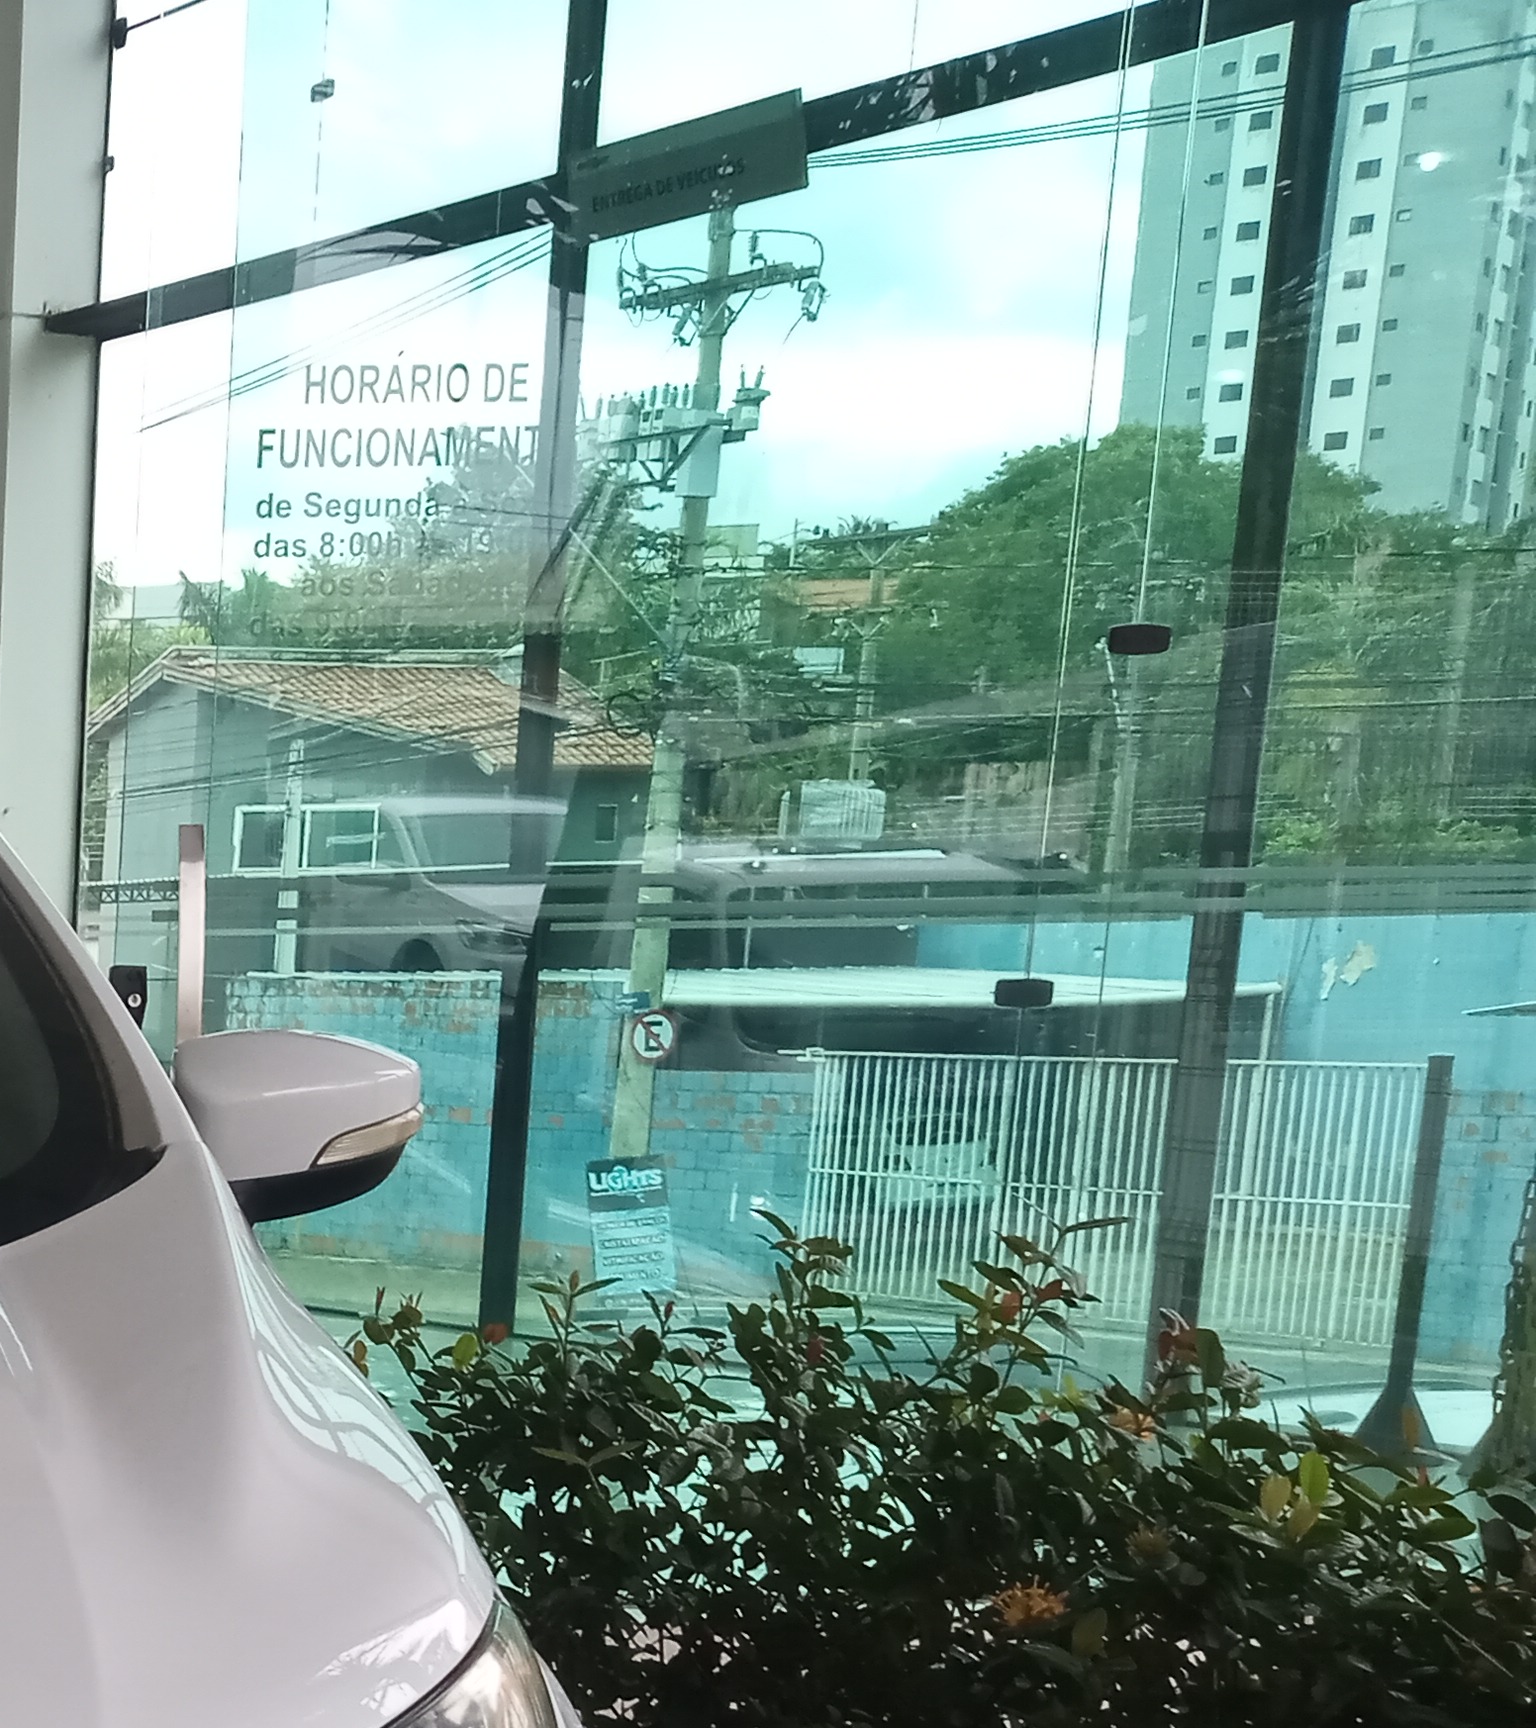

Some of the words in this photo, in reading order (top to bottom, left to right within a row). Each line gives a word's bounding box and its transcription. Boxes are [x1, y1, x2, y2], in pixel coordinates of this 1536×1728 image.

[592, 181, 653, 213] ENTREGA
[655, 175, 673, 197] DE
[304, 350, 470, 405] HORÁRIO
[484, 362, 530, 403] DE
[256, 424, 540, 469] FUNCIONAMENT
[256, 492, 292, 518] de
[303, 492, 440, 524] Segunda
[253, 532, 307, 558] das
[319, 531, 402, 558] 8:00h
[300, 576, 355, 597] aos
